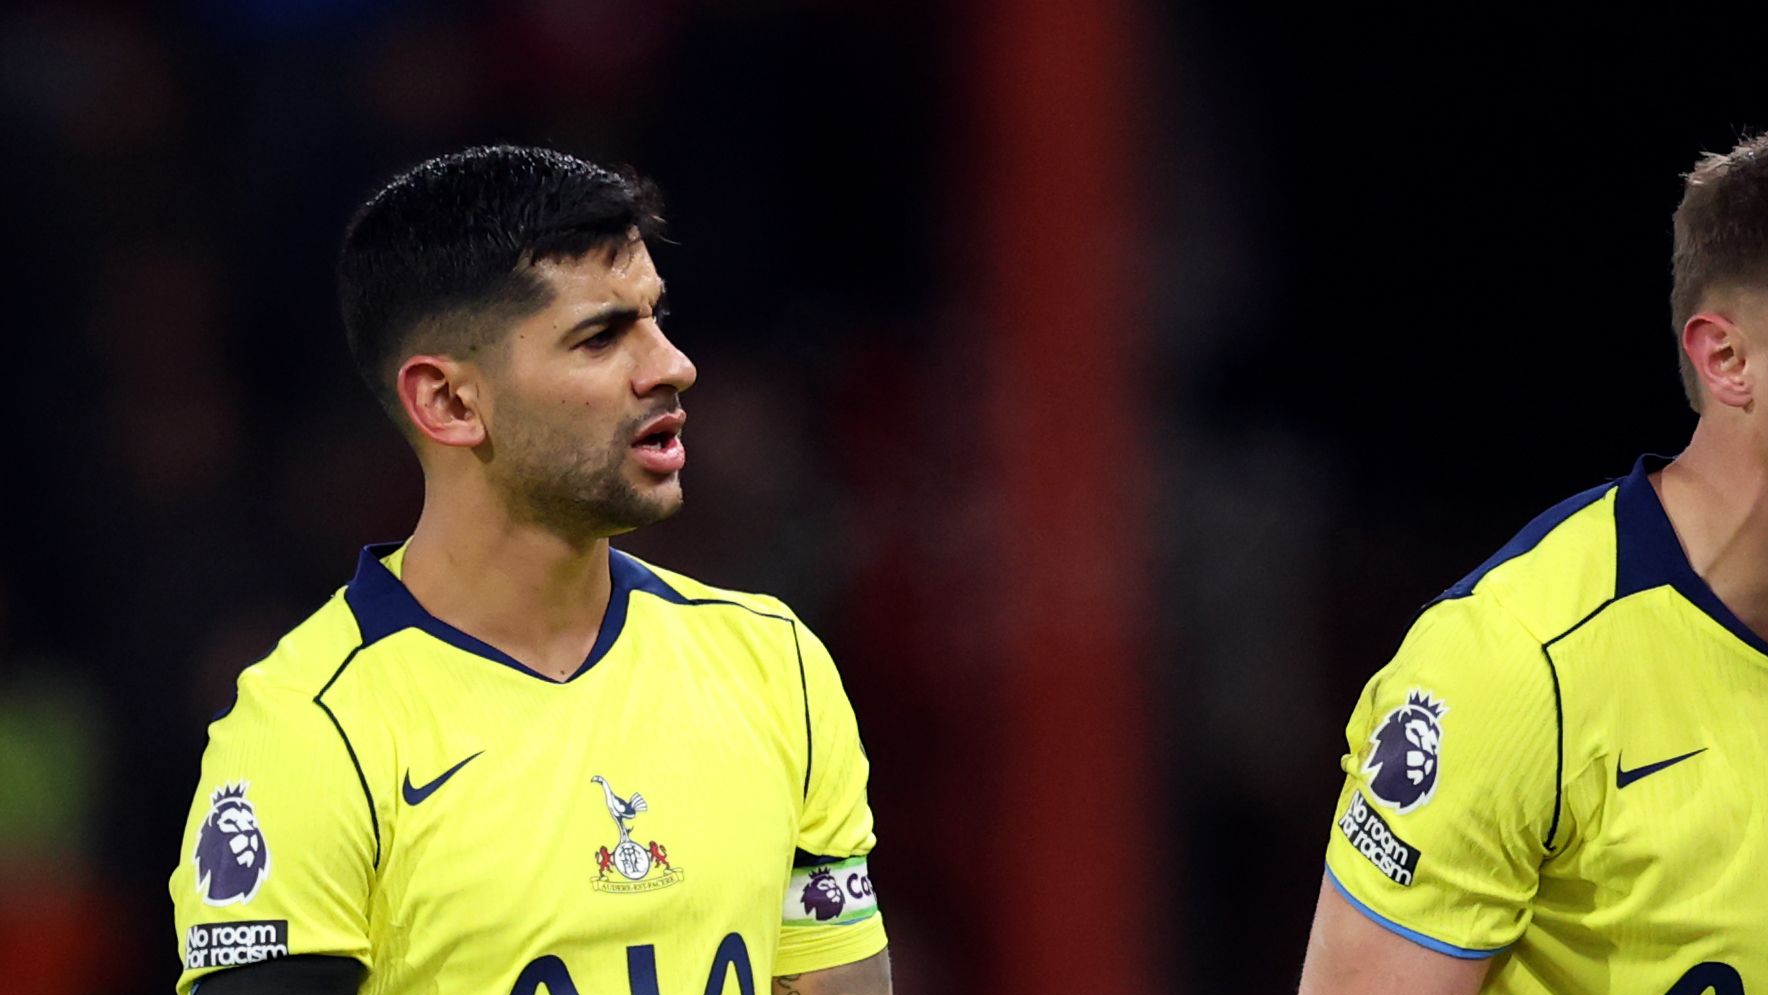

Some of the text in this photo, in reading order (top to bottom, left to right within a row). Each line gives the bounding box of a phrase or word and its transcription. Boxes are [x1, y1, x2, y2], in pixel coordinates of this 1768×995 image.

[1350, 790, 1408, 866] No room
[1353, 830, 1411, 886] racism
[187, 925, 276, 948] No room
[211, 944, 287, 966] racism
